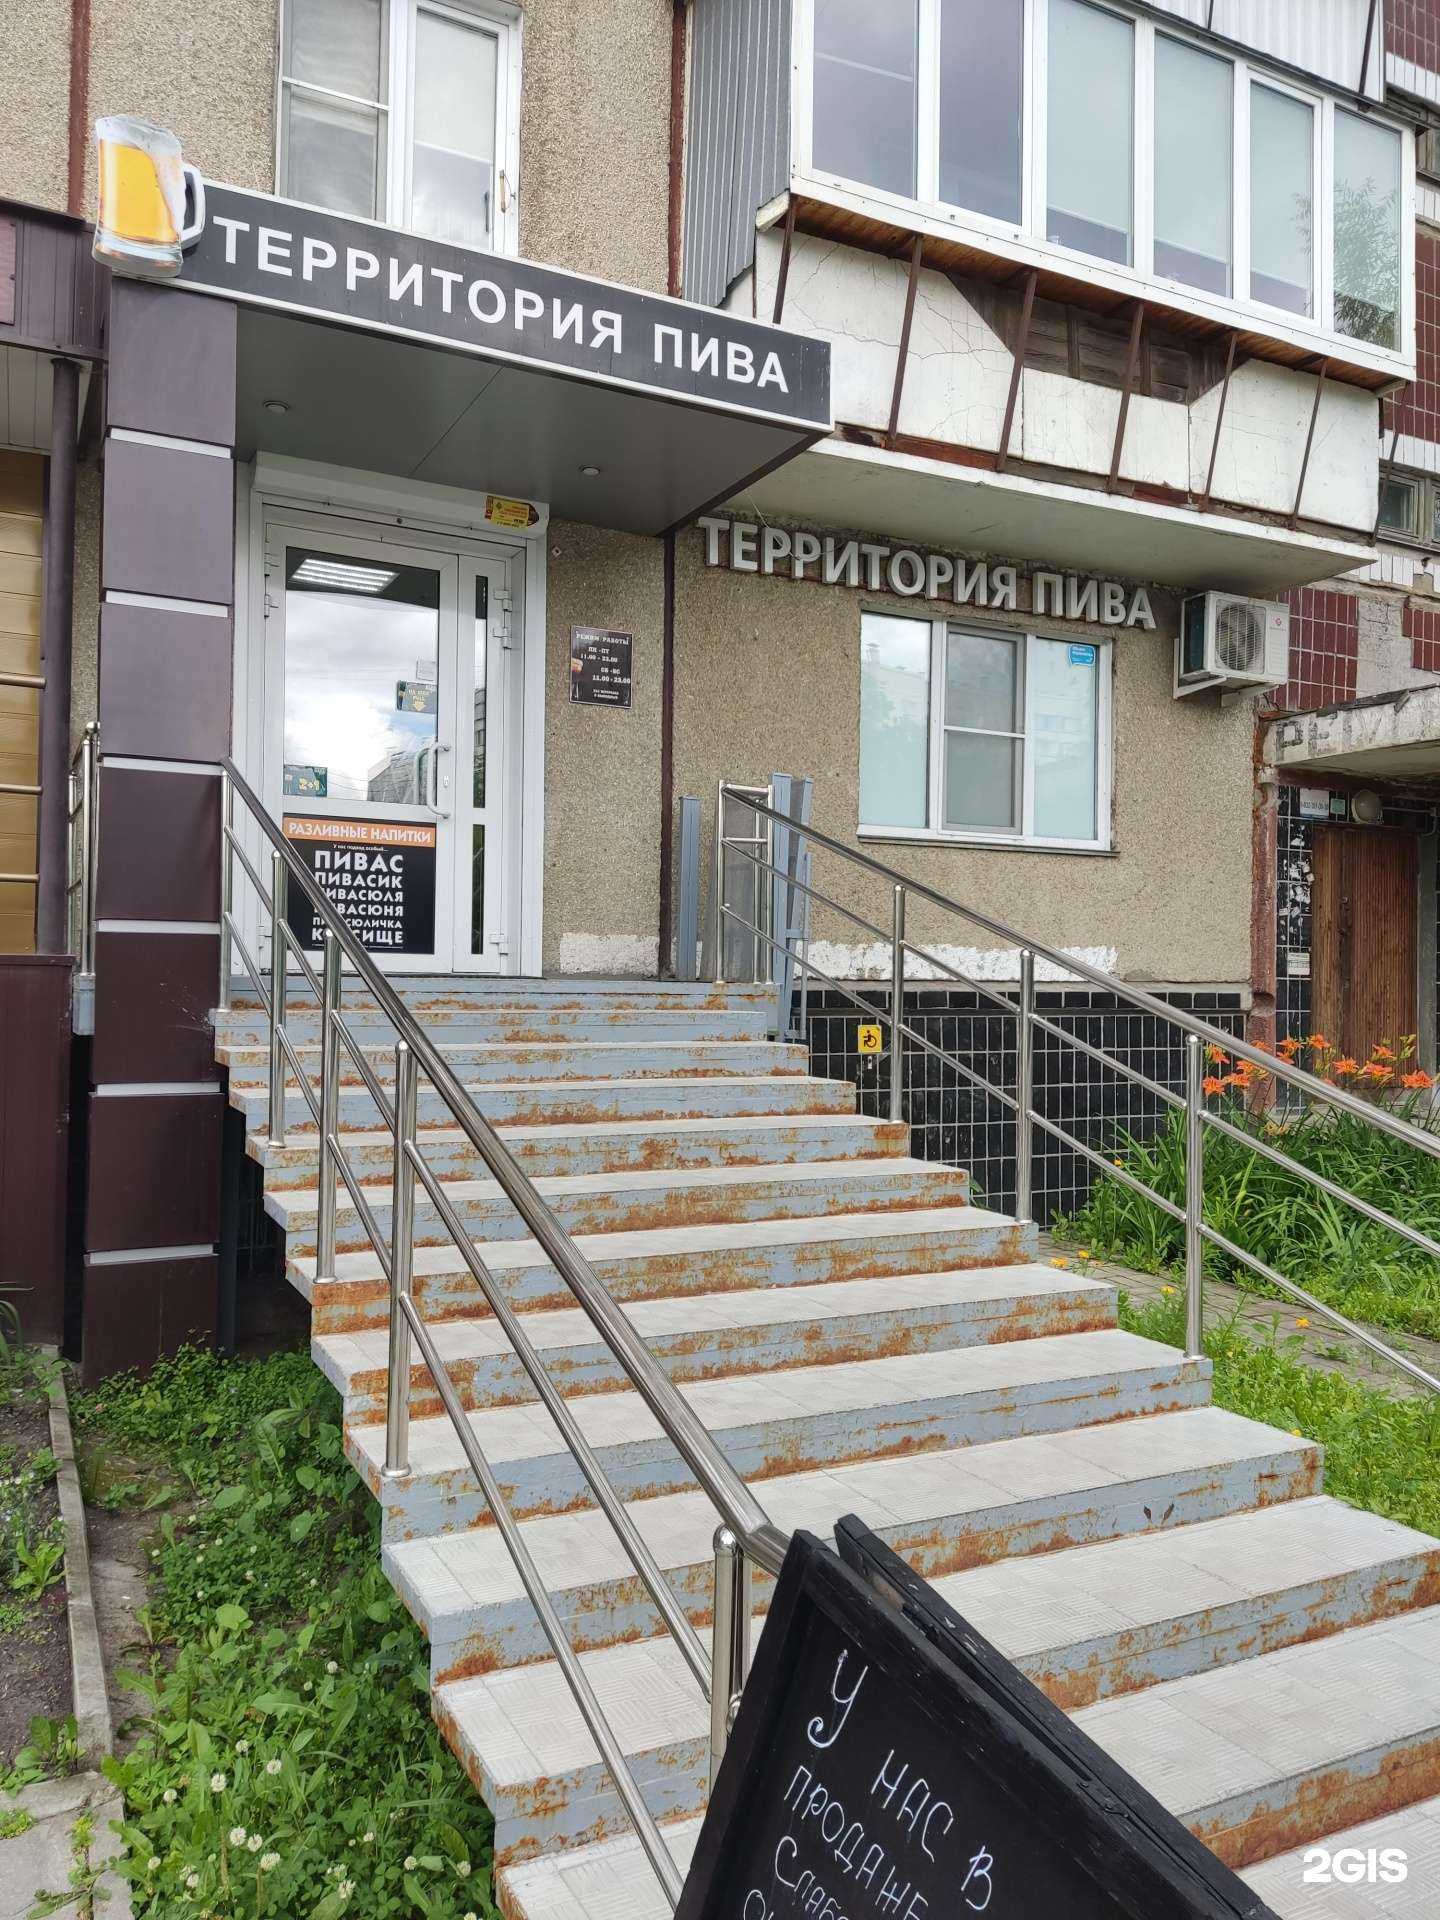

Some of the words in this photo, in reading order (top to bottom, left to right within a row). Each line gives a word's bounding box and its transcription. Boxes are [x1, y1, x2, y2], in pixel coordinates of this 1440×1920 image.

[213, 215, 623, 354] ТЕРРИТОРИЯ
[653, 323, 790, 393] ПИВА
[698, 516, 1017, 610] ТЕРРИТОРИЯ
[1032, 571, 1157, 630] ПИВА
[288, 822, 367, 839] РАЗЛИВНЫЕ
[370, 828, 431, 843] НАПИТКИ
[314, 850, 404, 873] ПИВАС
[314, 871, 402, 889] ПИВАСИК
[321, 887, 403, 903] ИВАСЮЛЯ
[314, 902, 403, 917] ВАСЮНЯ
[312, 927, 403, 945] КСИЩЕ
[807, 1649, 869, 1748] У
[870, 1749, 954, 1863] НАС
[960, 1845, 994, 1911] В
